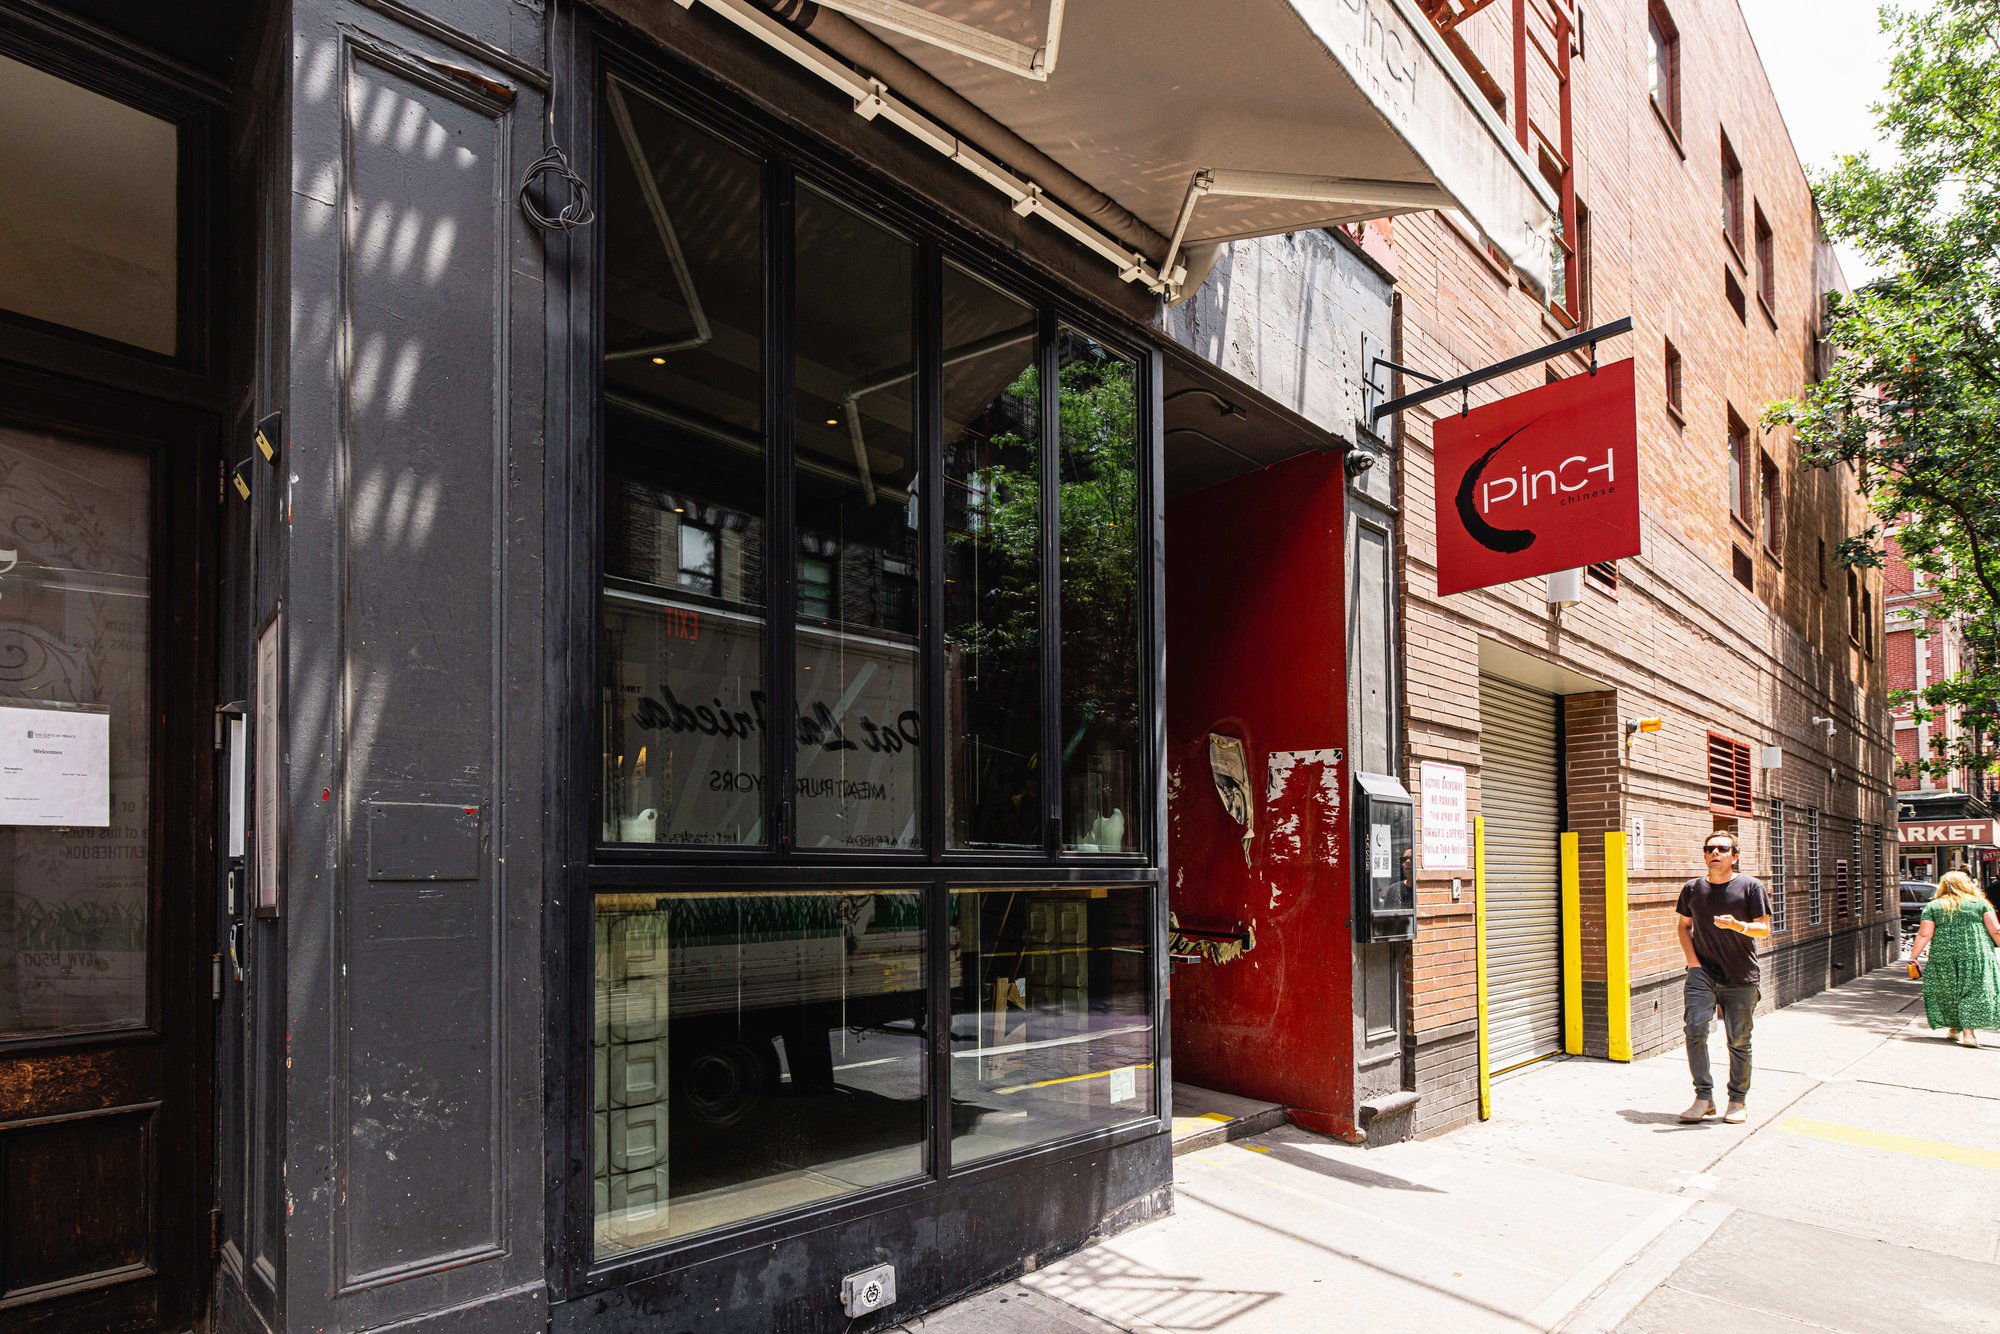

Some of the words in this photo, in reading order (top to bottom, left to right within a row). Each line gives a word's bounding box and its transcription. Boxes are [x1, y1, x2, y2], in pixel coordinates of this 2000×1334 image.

[1345, 43, 1409, 128] chinese
[1559, 485, 1616, 506] chinese
[1425, 777, 1440, 790] ACTIVE
[1441, 779, 1463, 791] DRIVEWAY
[1431, 795, 1438, 805] NO
[1439, 796, 1458, 807] PARKING
[1897, 824, 1986, 843] ARKET
